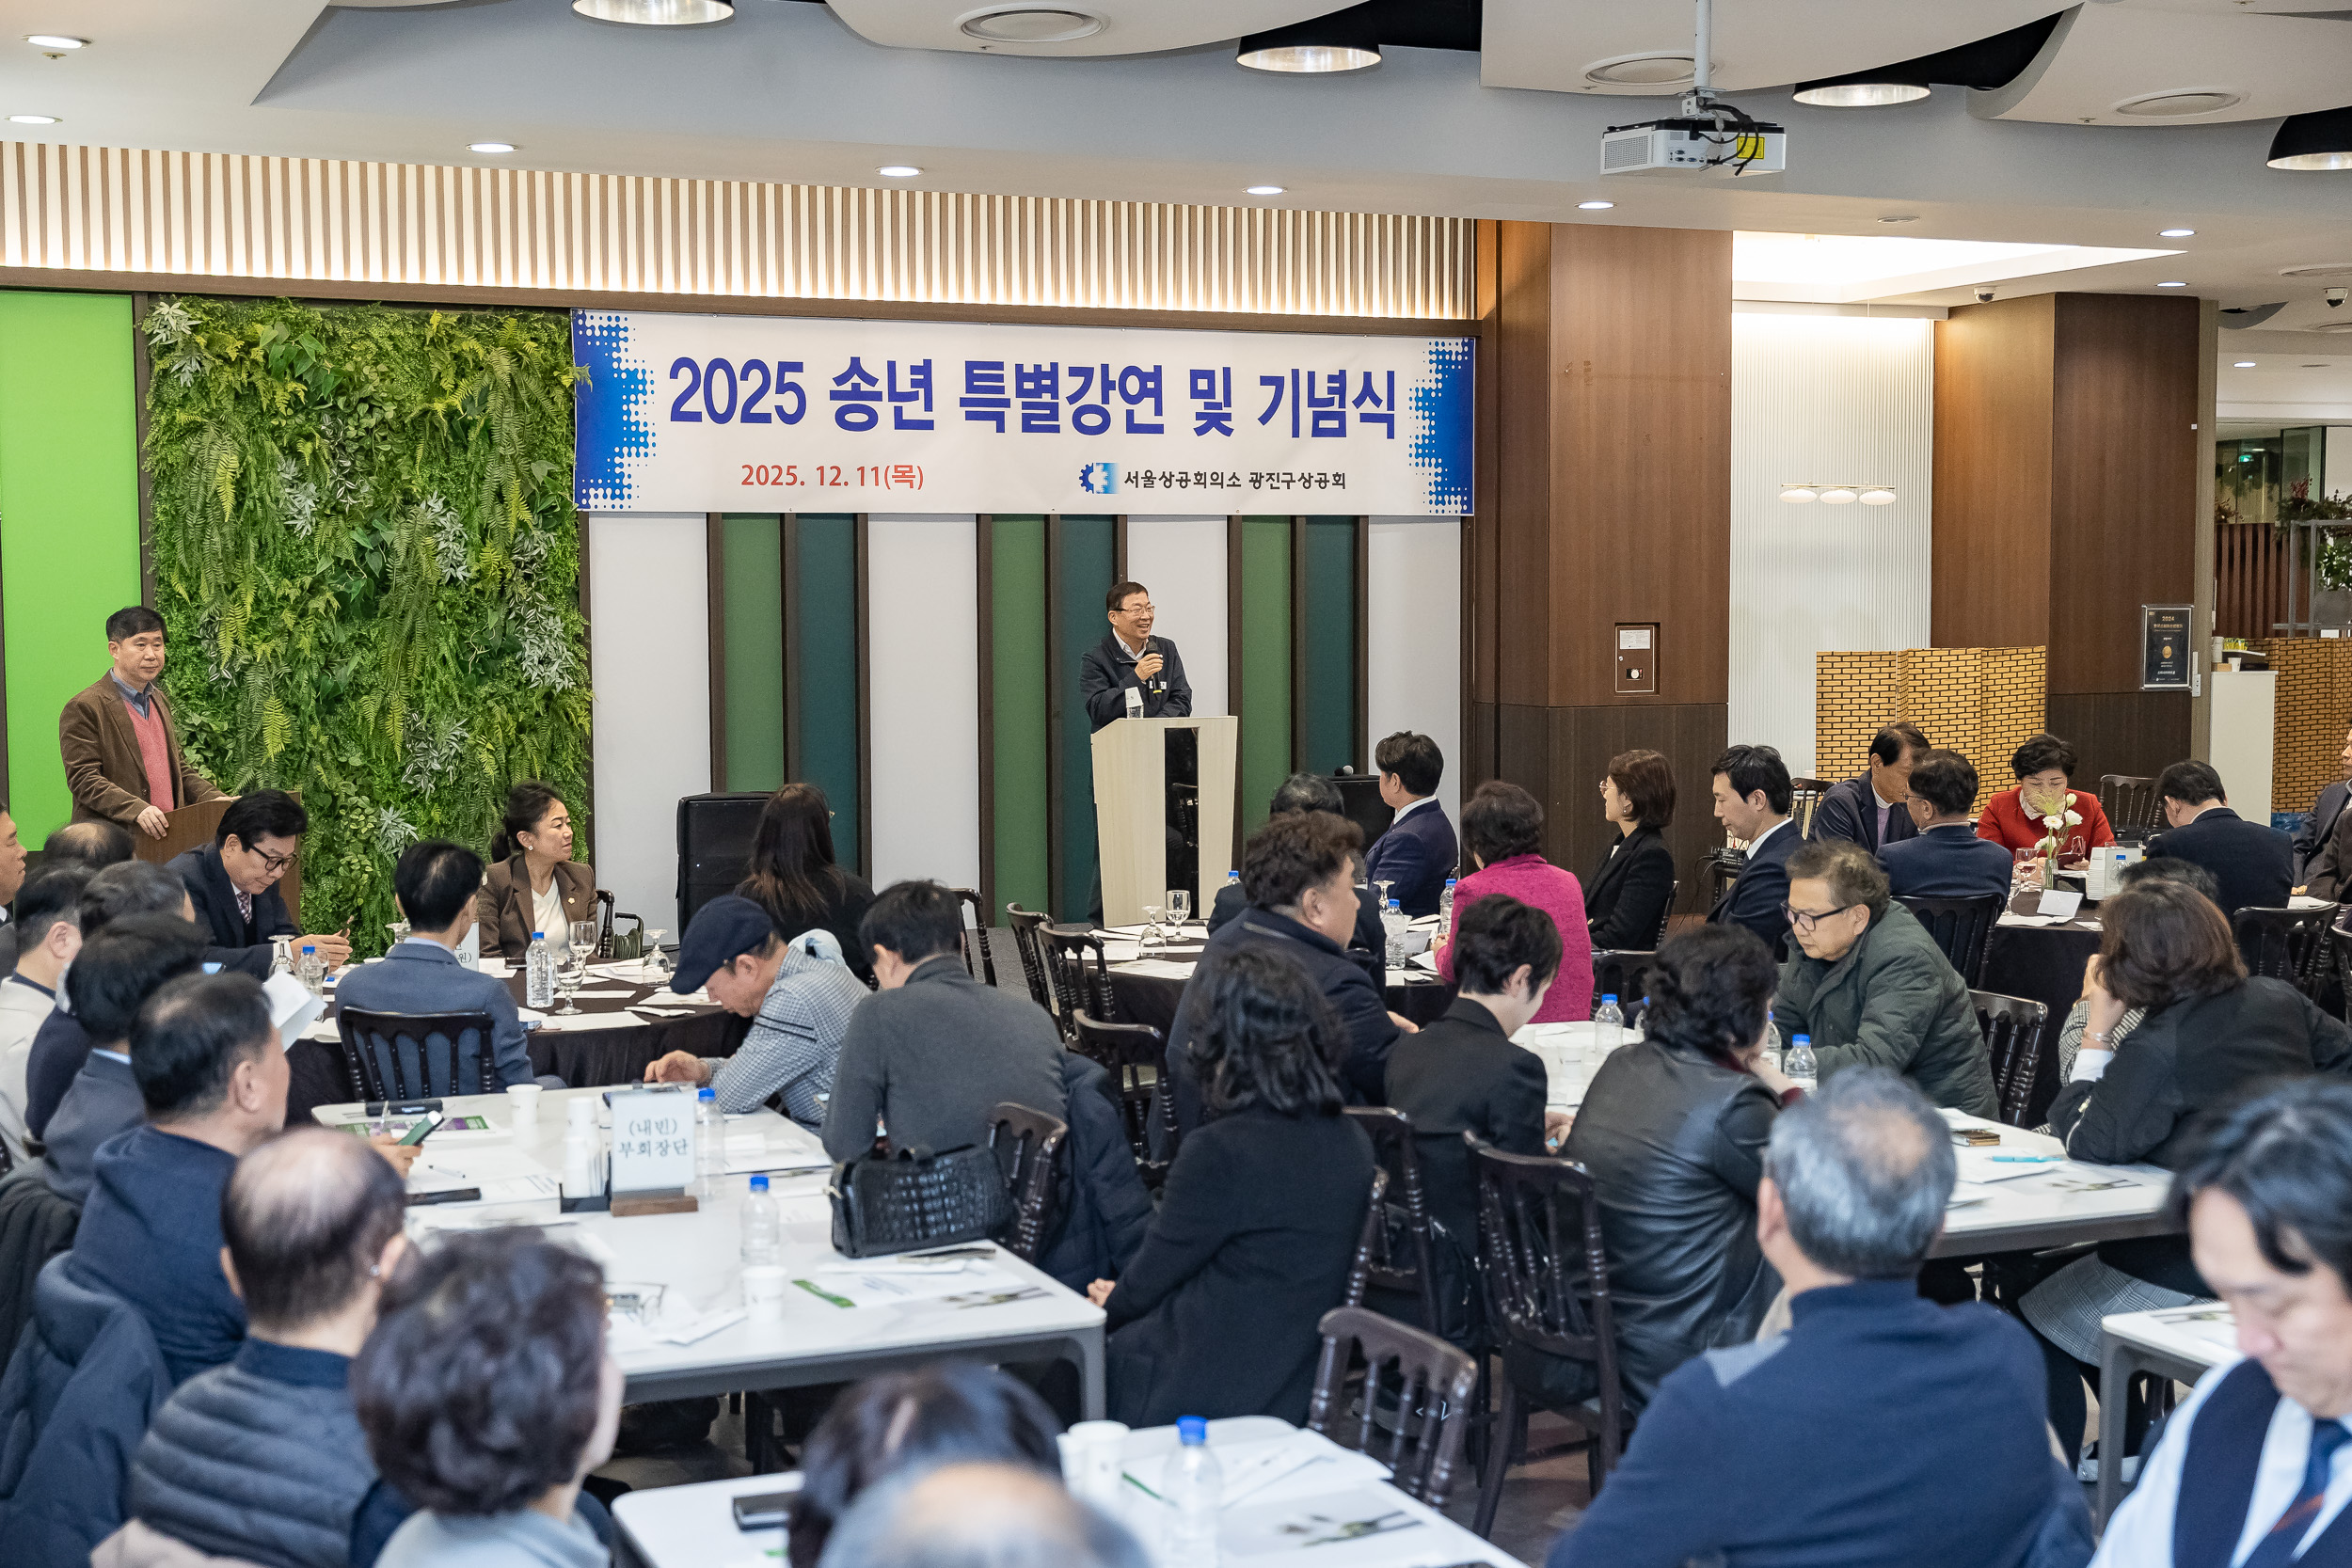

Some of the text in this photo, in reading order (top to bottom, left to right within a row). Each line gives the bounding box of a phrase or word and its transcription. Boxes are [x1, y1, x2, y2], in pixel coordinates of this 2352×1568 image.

[669, 356, 1396, 439] 2025 송년 특별강연 및 기념식
[740, 464, 924, 491] 2025. 12. 11(목)
[1123, 469, 1347, 490] 서울상공회의소 광진구상공회
[628, 1117, 678, 1137] (내빈)
[618, 1137, 689, 1159] 부회장단
